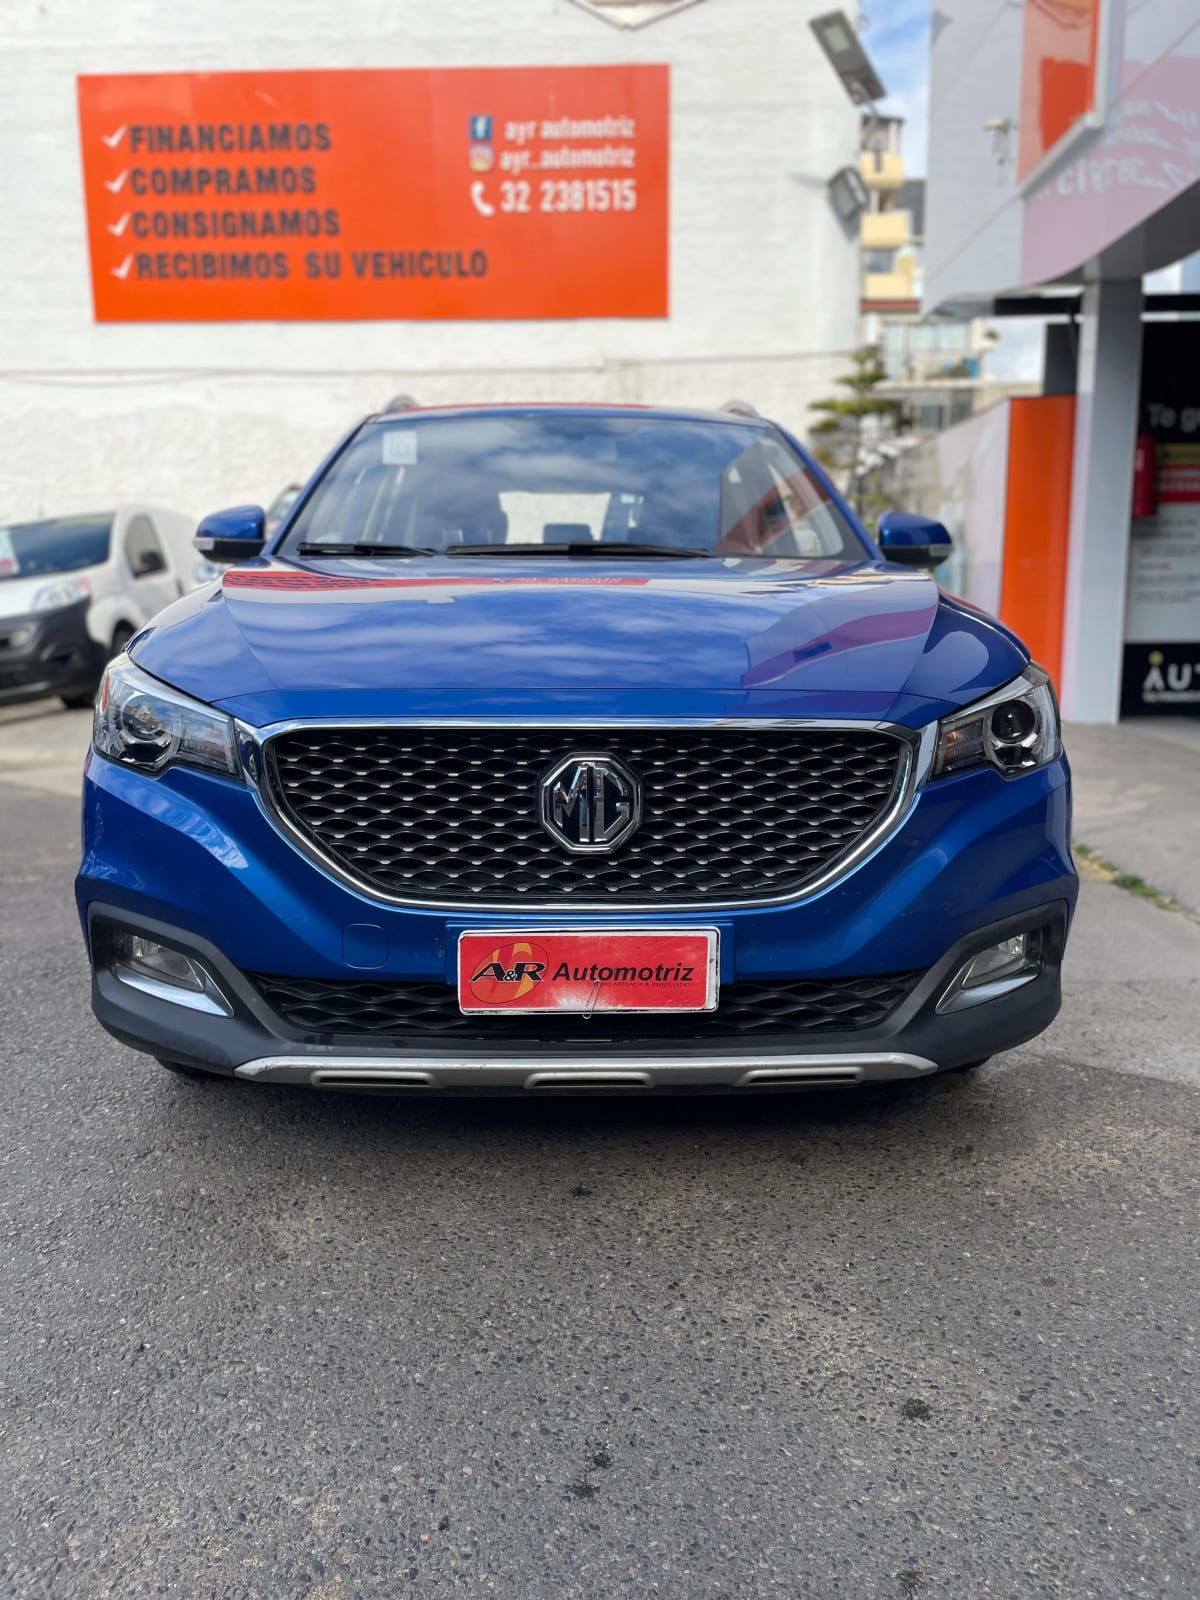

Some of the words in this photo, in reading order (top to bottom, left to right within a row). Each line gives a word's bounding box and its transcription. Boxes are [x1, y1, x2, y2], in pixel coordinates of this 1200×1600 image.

[130, 123, 331, 152] FINANCIAMOS
[541, 116, 636, 140] automotriz
[130, 167, 316, 195] COMPRAMOS
[501, 180, 531, 213] 32
[540, 179, 637, 212] 2381515
[133, 210, 339, 238] CONSIGNAMOS
[136, 252, 289, 280] RECIBIMOS
[306, 252, 341, 279] SU
[353, 250, 488, 279] VEHICULO
[553, 762, 630, 842] MG
[470, 962, 545, 982] A&R
[552, 962, 694, 981] Automotriz
